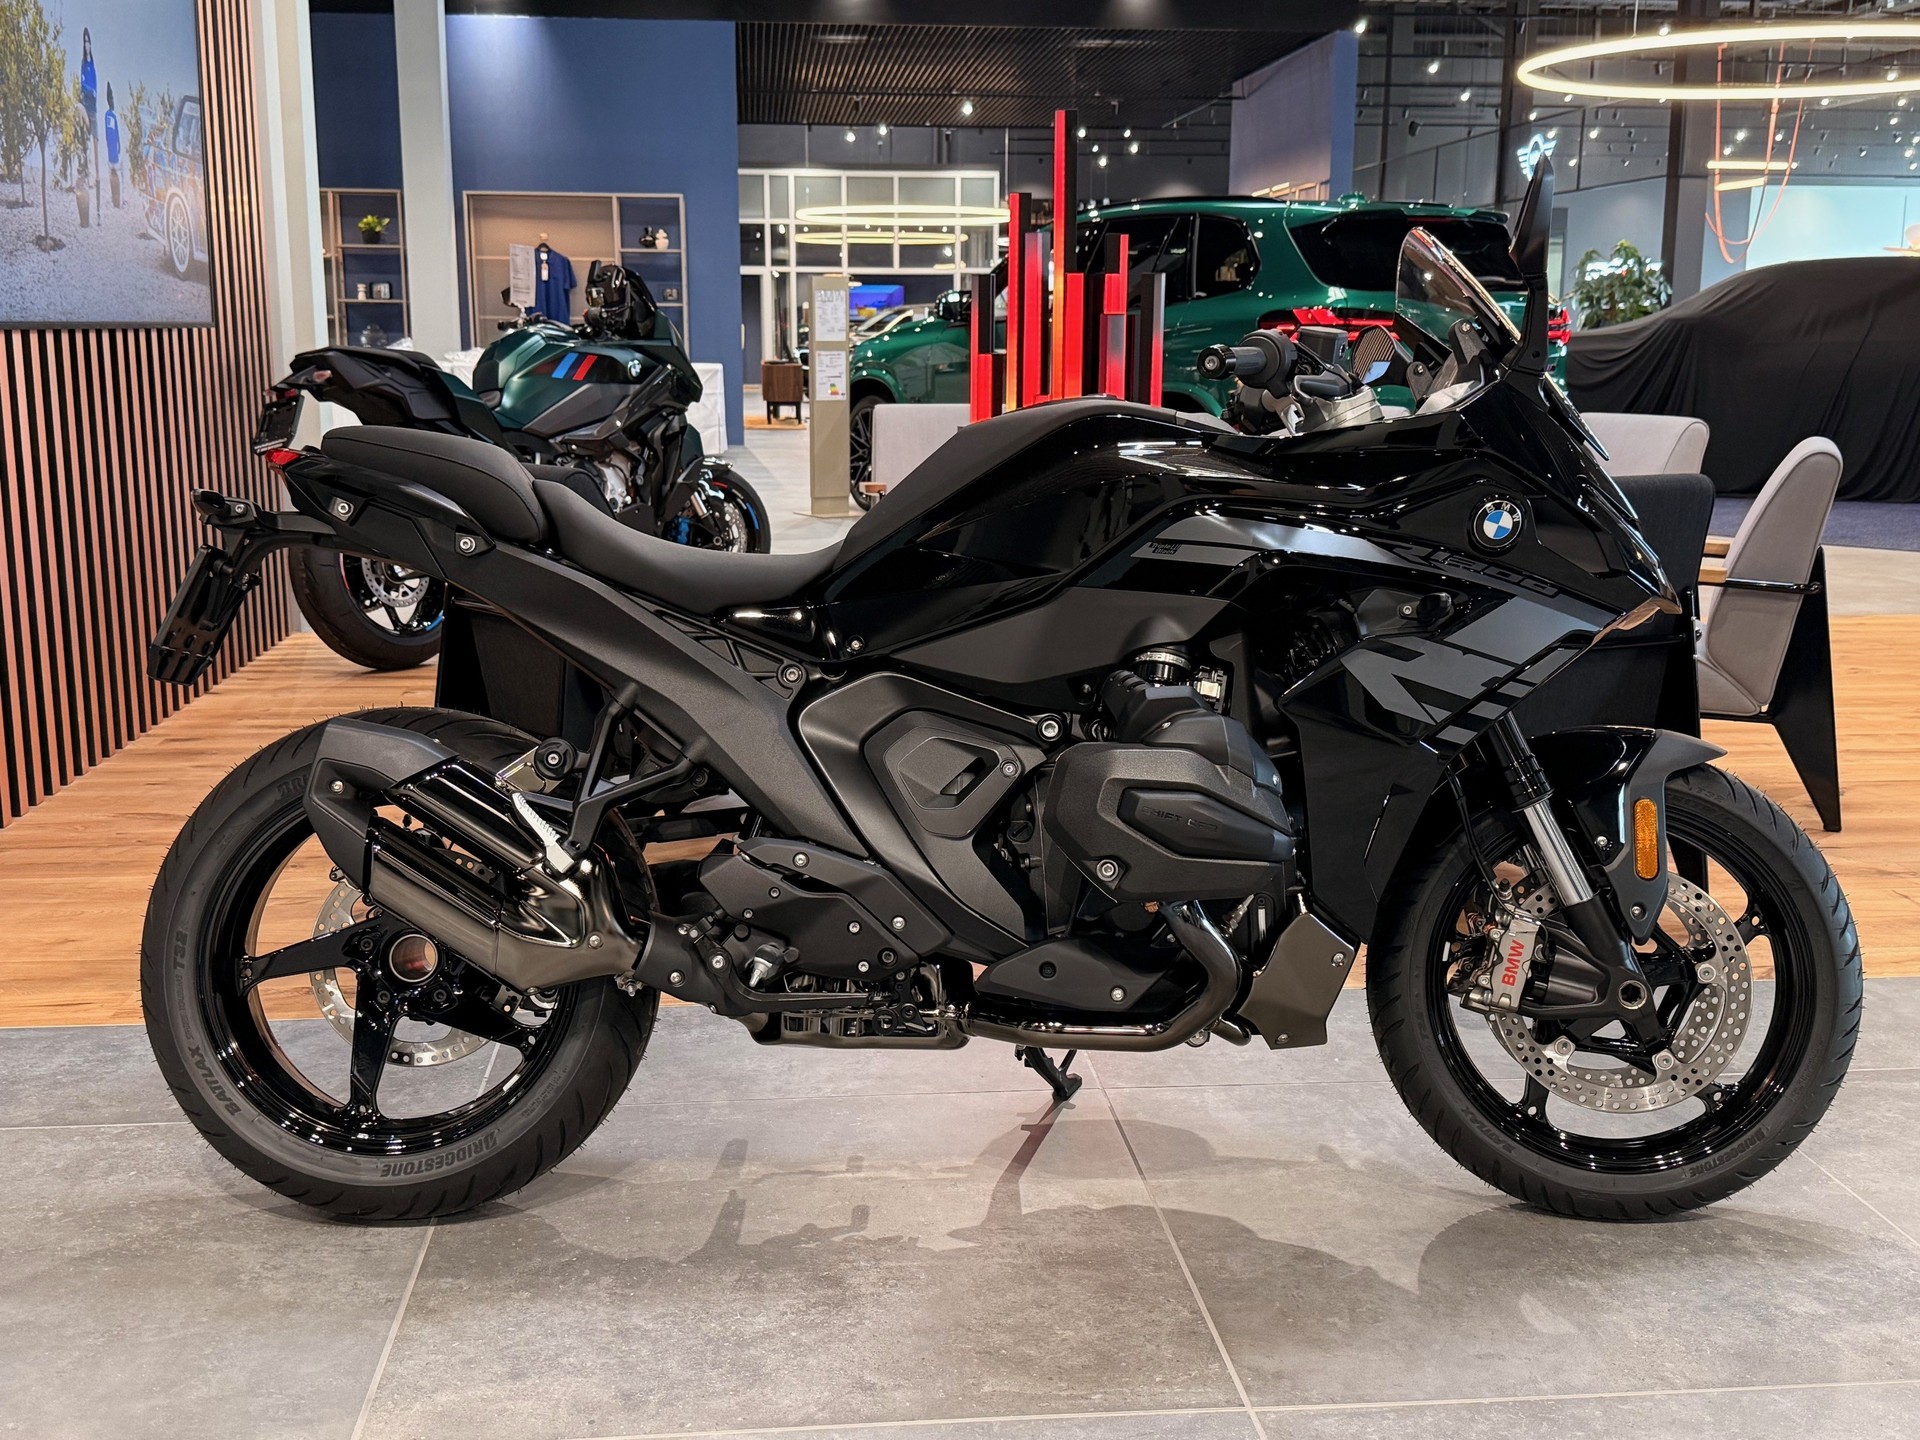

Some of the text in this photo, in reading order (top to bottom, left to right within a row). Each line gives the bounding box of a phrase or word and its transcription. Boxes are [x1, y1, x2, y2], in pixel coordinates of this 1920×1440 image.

[1486, 502, 1521, 522] BMW
[1141, 806, 1182, 822] SHIFT
[173, 930, 189, 970] T32
[1501, 938, 1525, 987] BMW
[380, 1129, 500, 1178] BRIDGESTONE
[1688, 1129, 1767, 1178] BRIDGESTONE
